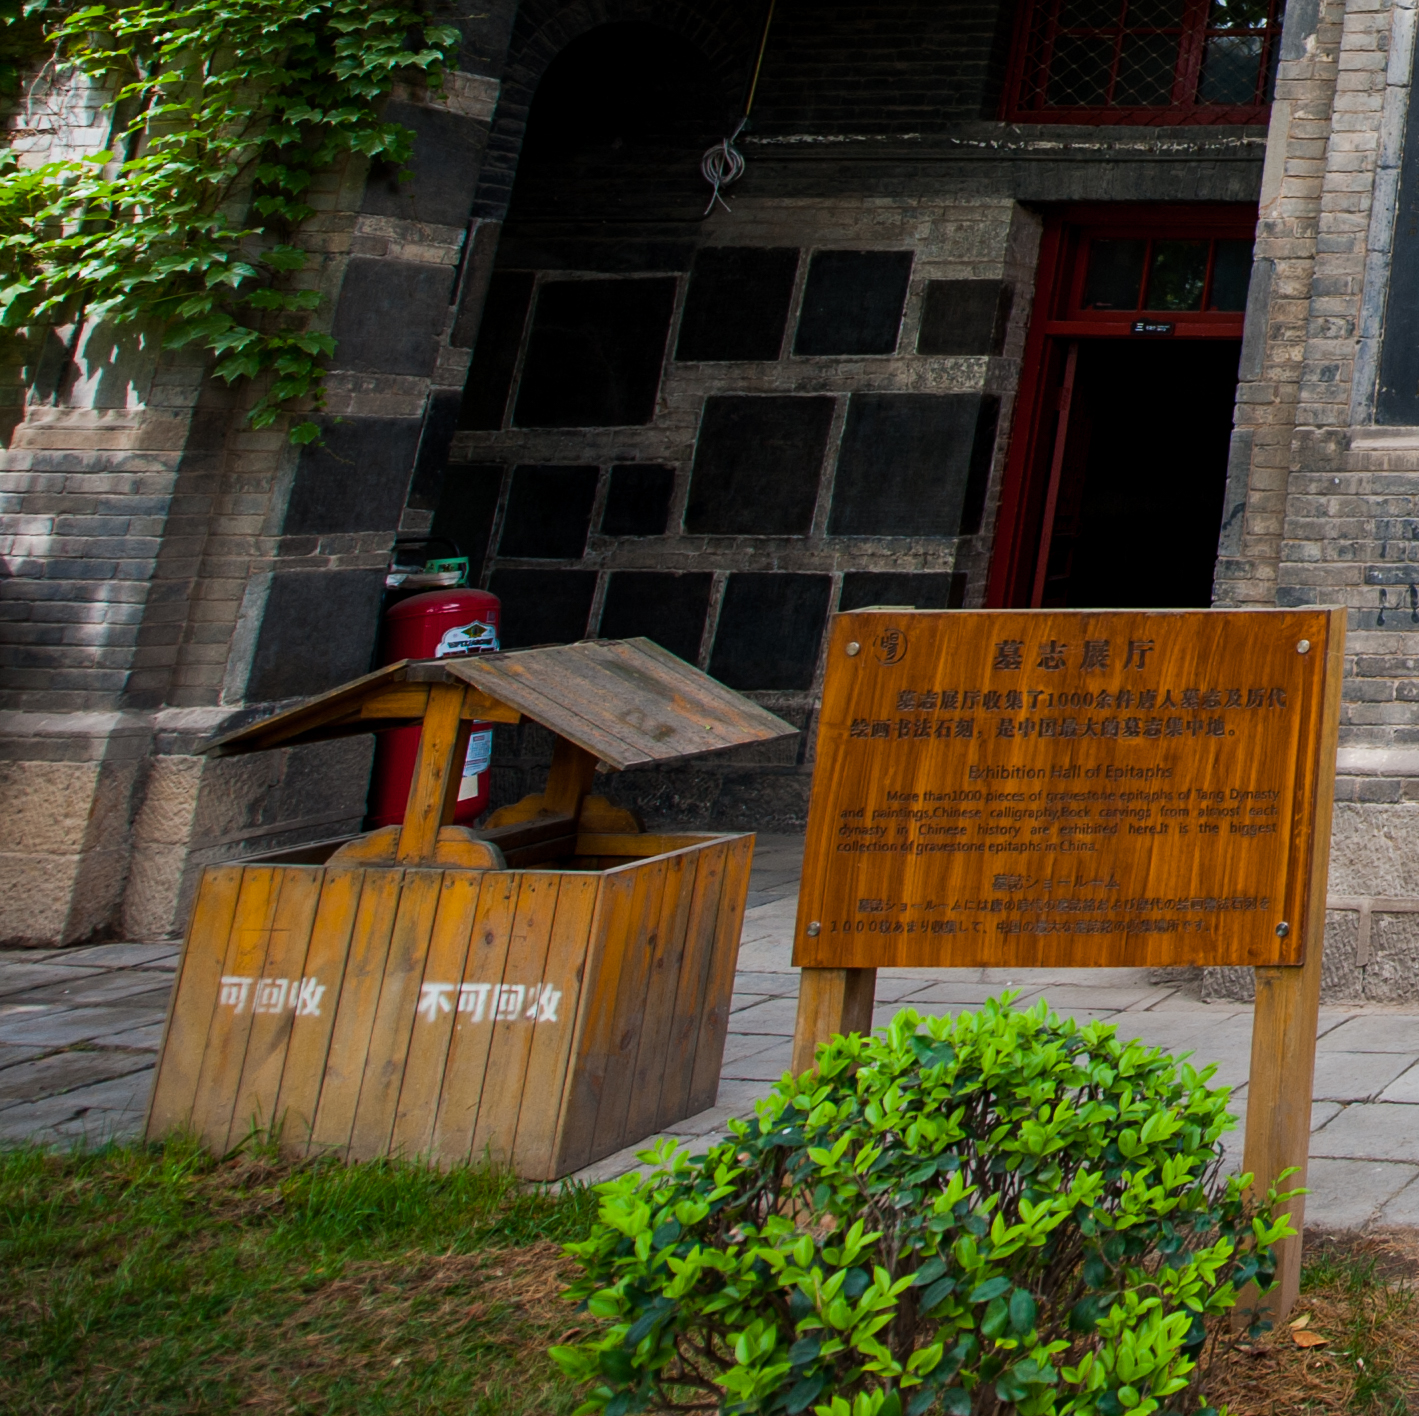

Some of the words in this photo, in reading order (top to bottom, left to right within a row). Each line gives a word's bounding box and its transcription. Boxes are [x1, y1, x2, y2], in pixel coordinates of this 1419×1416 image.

[994, 639, 1155, 672] 墓志展厅
[896, 688, 1287, 712] 墓志展厅收集了1000余件唐人墓志及历代
[968, 765, 1046, 780] Exhibition
[1050, 765, 1081, 779] Hall
[1085, 764, 1101, 779] of
[1105, 764, 1173, 782] Epitaphs
[886, 790, 919, 802] More
[985, 790, 1025, 805] pieces
[1028, 789, 1043, 802] of
[1046, 790, 1116, 805] gravestone
[1119, 789, 1174, 803] epitaphs
[1178, 788, 1192, 801] of
[1195, 789, 1224, 804] Tang
[1229, 788, 1280, 803] Dynasty
[840, 806, 864, 819] and
[1098, 805, 1152, 822] carvings
[1160, 805, 1190, 818] from
[1197, 805, 1241, 817] almost
[1248, 805, 1278, 817] each
[838, 823, 887, 838] dynasty
[896, 823, 908, 835] in
[918, 823, 967, 836] Chinese
[976, 822, 1021, 838] history
[1030, 825, 1050, 836] are
[1059, 822, 1118, 836] exhibited
[1178, 821, 1189, 834] is
[1198, 821, 1219, 834] the
[1228, 821, 1277, 837] biggest
[836, 840, 897, 853] collection
[900, 839, 914, 853] of
[916, 840, 986, 856] gravestone
[988, 840, 1042, 855] epitaphs
[1045, 839, 1056, 852] in
[1058, 839, 1098, 853] China.
[219, 975, 327, 1017] 可回收
[417, 981, 563, 1024] 不可回收
